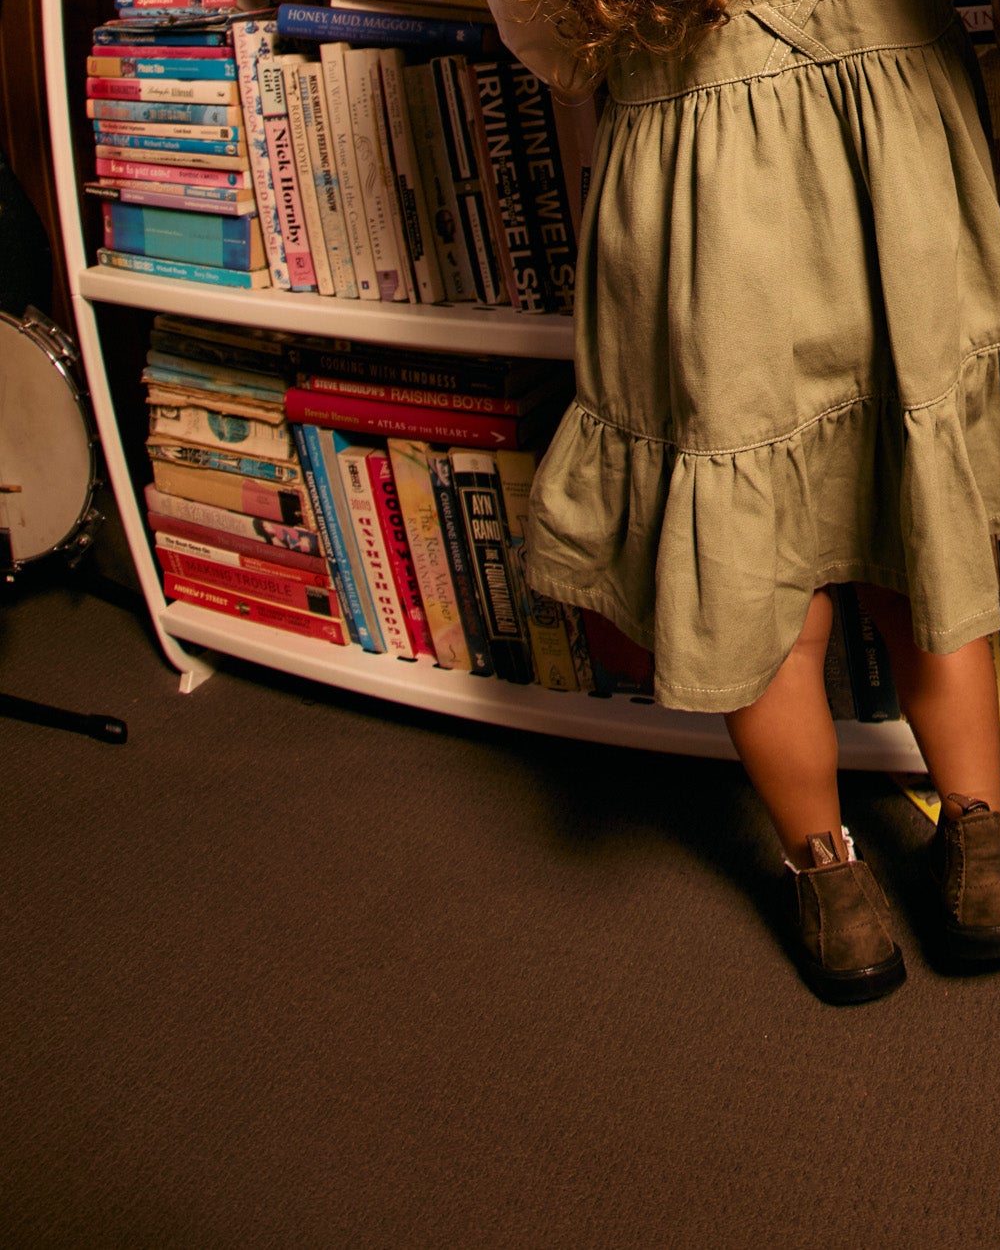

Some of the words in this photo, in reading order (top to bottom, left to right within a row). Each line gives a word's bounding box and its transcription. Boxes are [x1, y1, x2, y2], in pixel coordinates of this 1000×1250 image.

[362, 17, 424, 32] MAGGOTS
[262, 68, 274, 94] Girl
[271, 67, 285, 106] Funny
[473, 63, 518, 185] IRVINE
[510, 63, 555, 183] IRVINE
[272, 126, 292, 173] Nick
[308, 74, 318, 95] MISS
[326, 187, 338, 213] SNOW
[279, 176, 303, 246] Hornby
[313, 378, 338, 392] STEVE
[390, 388, 449, 407] RAISING
[452, 394, 494, 412] BOYS
[331, 411, 360, 425] Brown
[377, 418, 406, 431] ATLAS
[435, 425, 468, 439] HEART
[418, 504, 431, 533] The
[472, 493, 492, 516] AYN
[473, 520, 501, 541] RAND
[424, 535, 442, 568] Rice
[173, 583, 200, 599] ANDREW
[205, 592, 229, 608] STREET
[234, 569, 293, 597] TROUBLE
[434, 567, 452, 622] Mother
